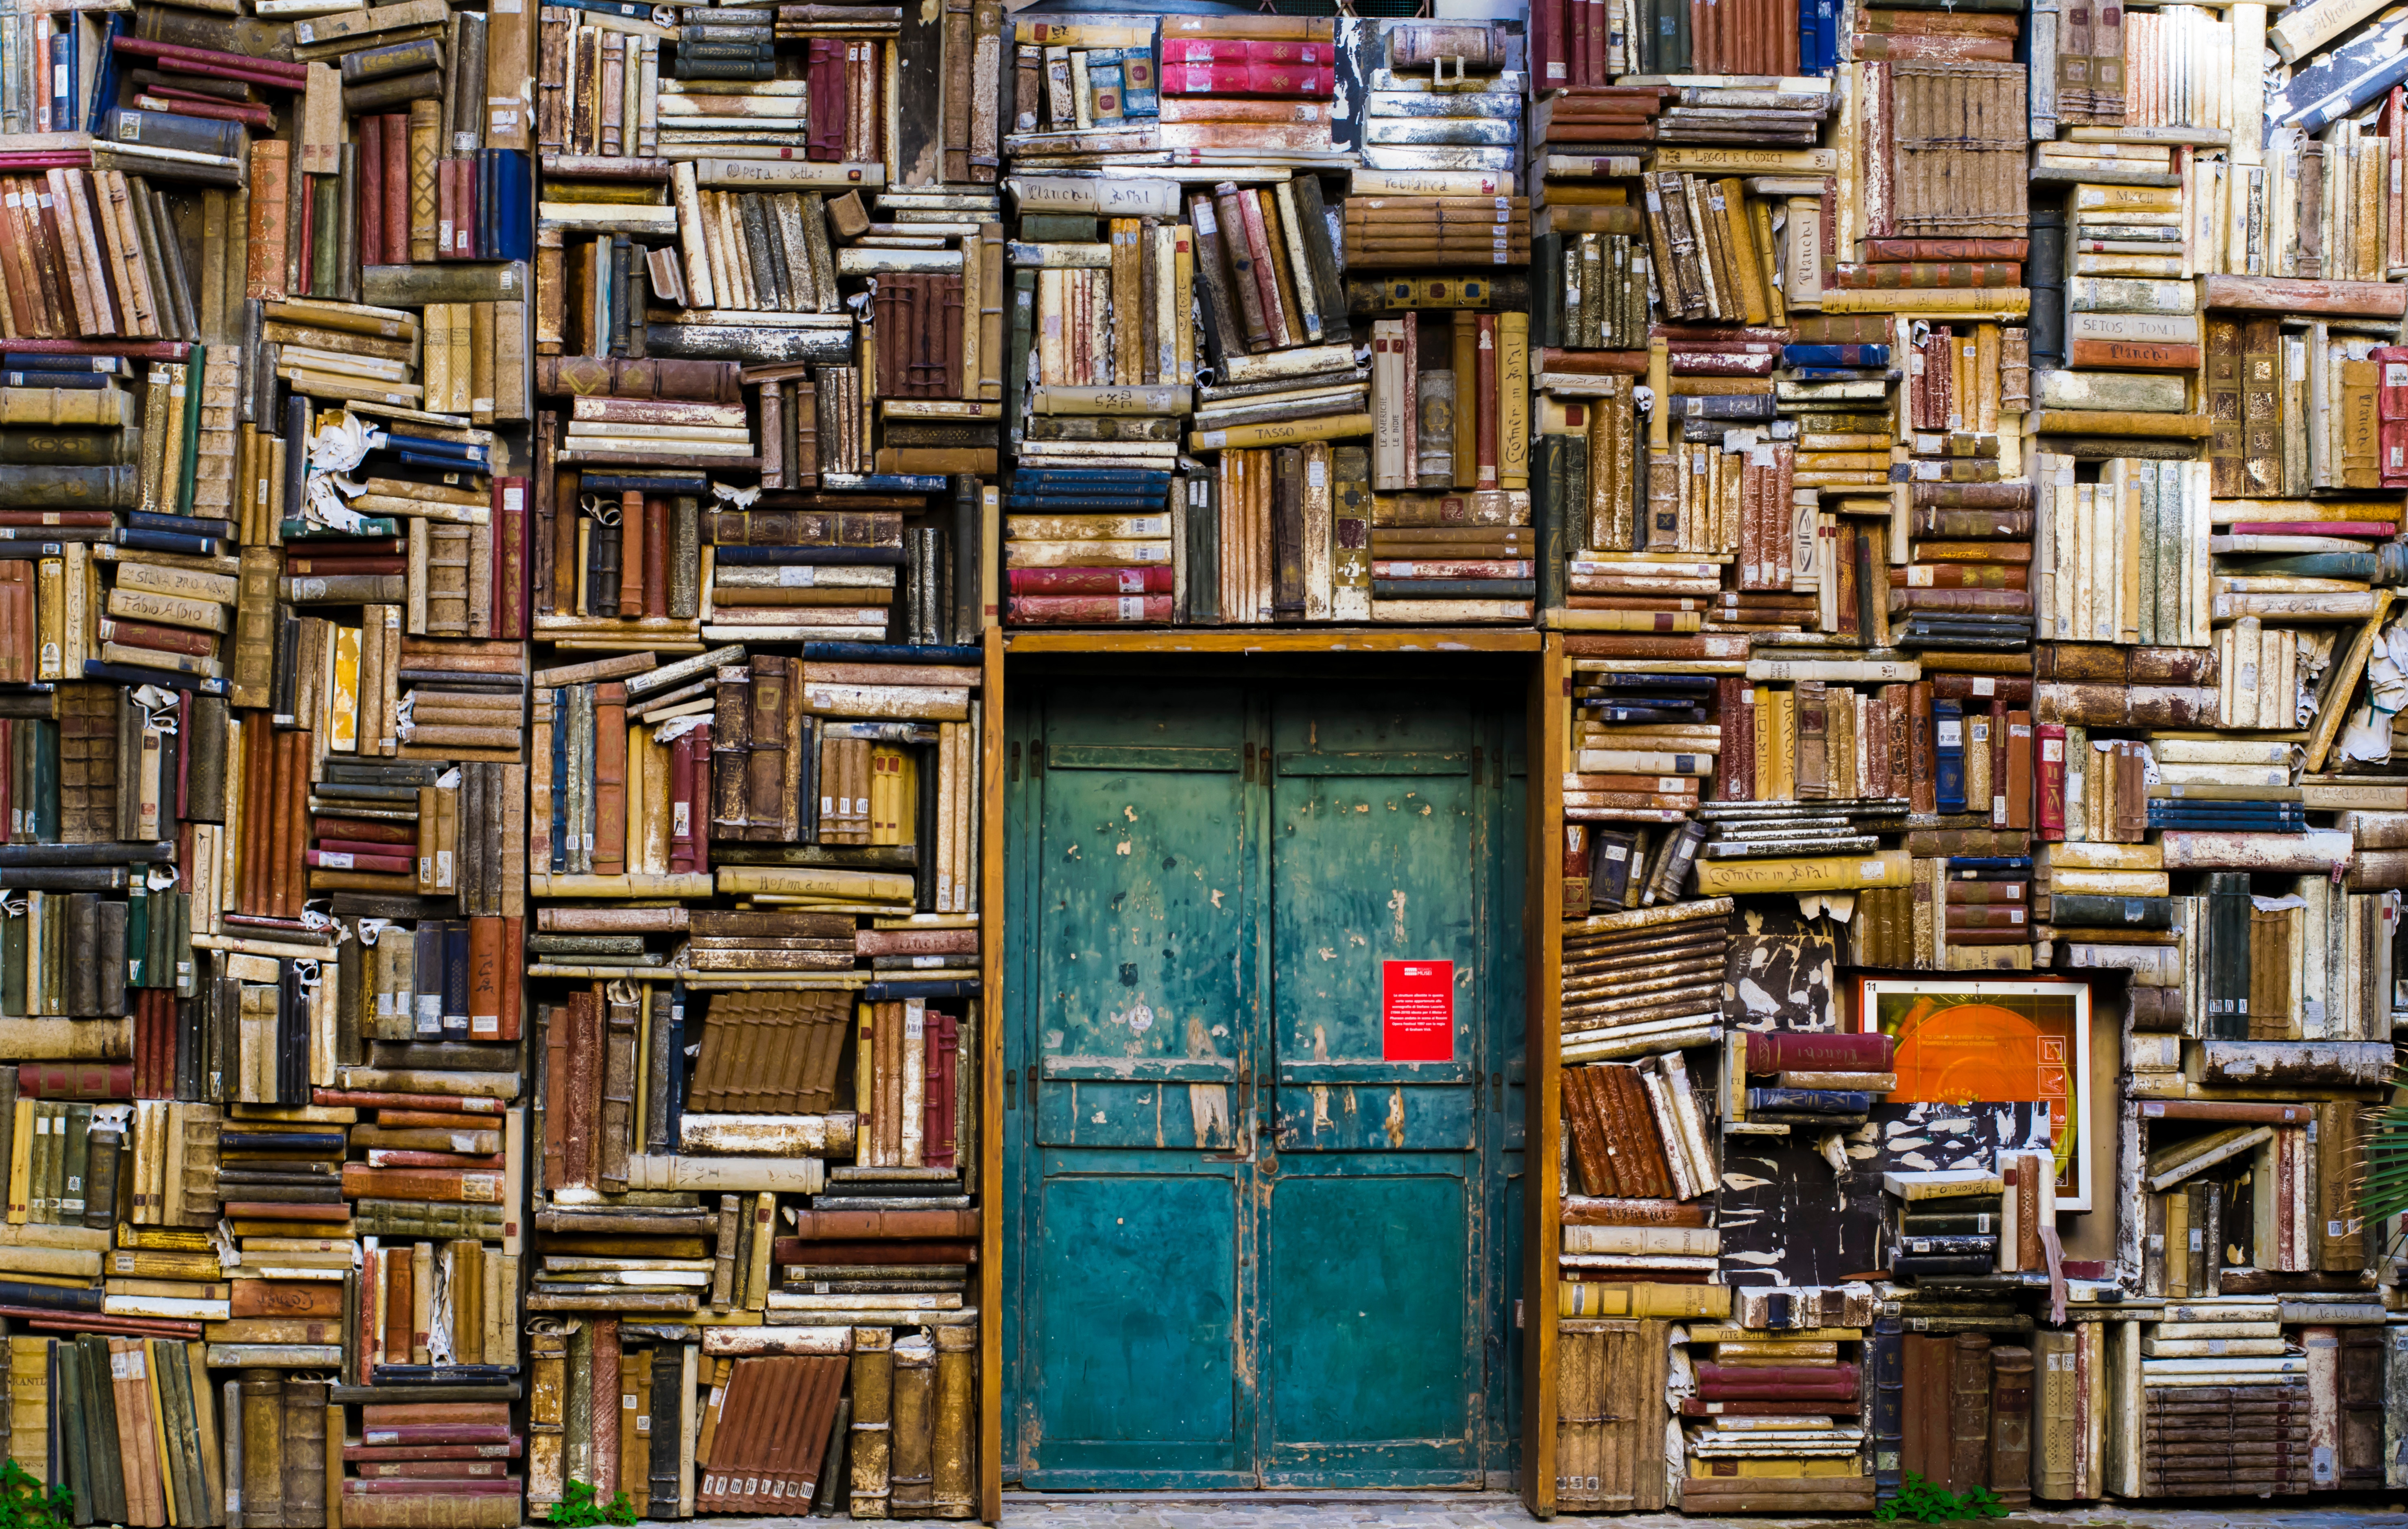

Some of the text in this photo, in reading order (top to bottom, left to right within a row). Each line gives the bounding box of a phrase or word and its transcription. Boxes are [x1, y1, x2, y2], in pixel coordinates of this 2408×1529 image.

[1255, 427, 1294, 439] TASSO
[1380, 438, 1387, 448] LE
[1392, 438, 1399, 447] LE
[1866, 982, 1876, 992] 11
[1932, 1088, 1955, 1102] SAFE
[1940, 1181, 1988, 1194] Petronio
[1717, 1330, 1738, 1339] VITE
